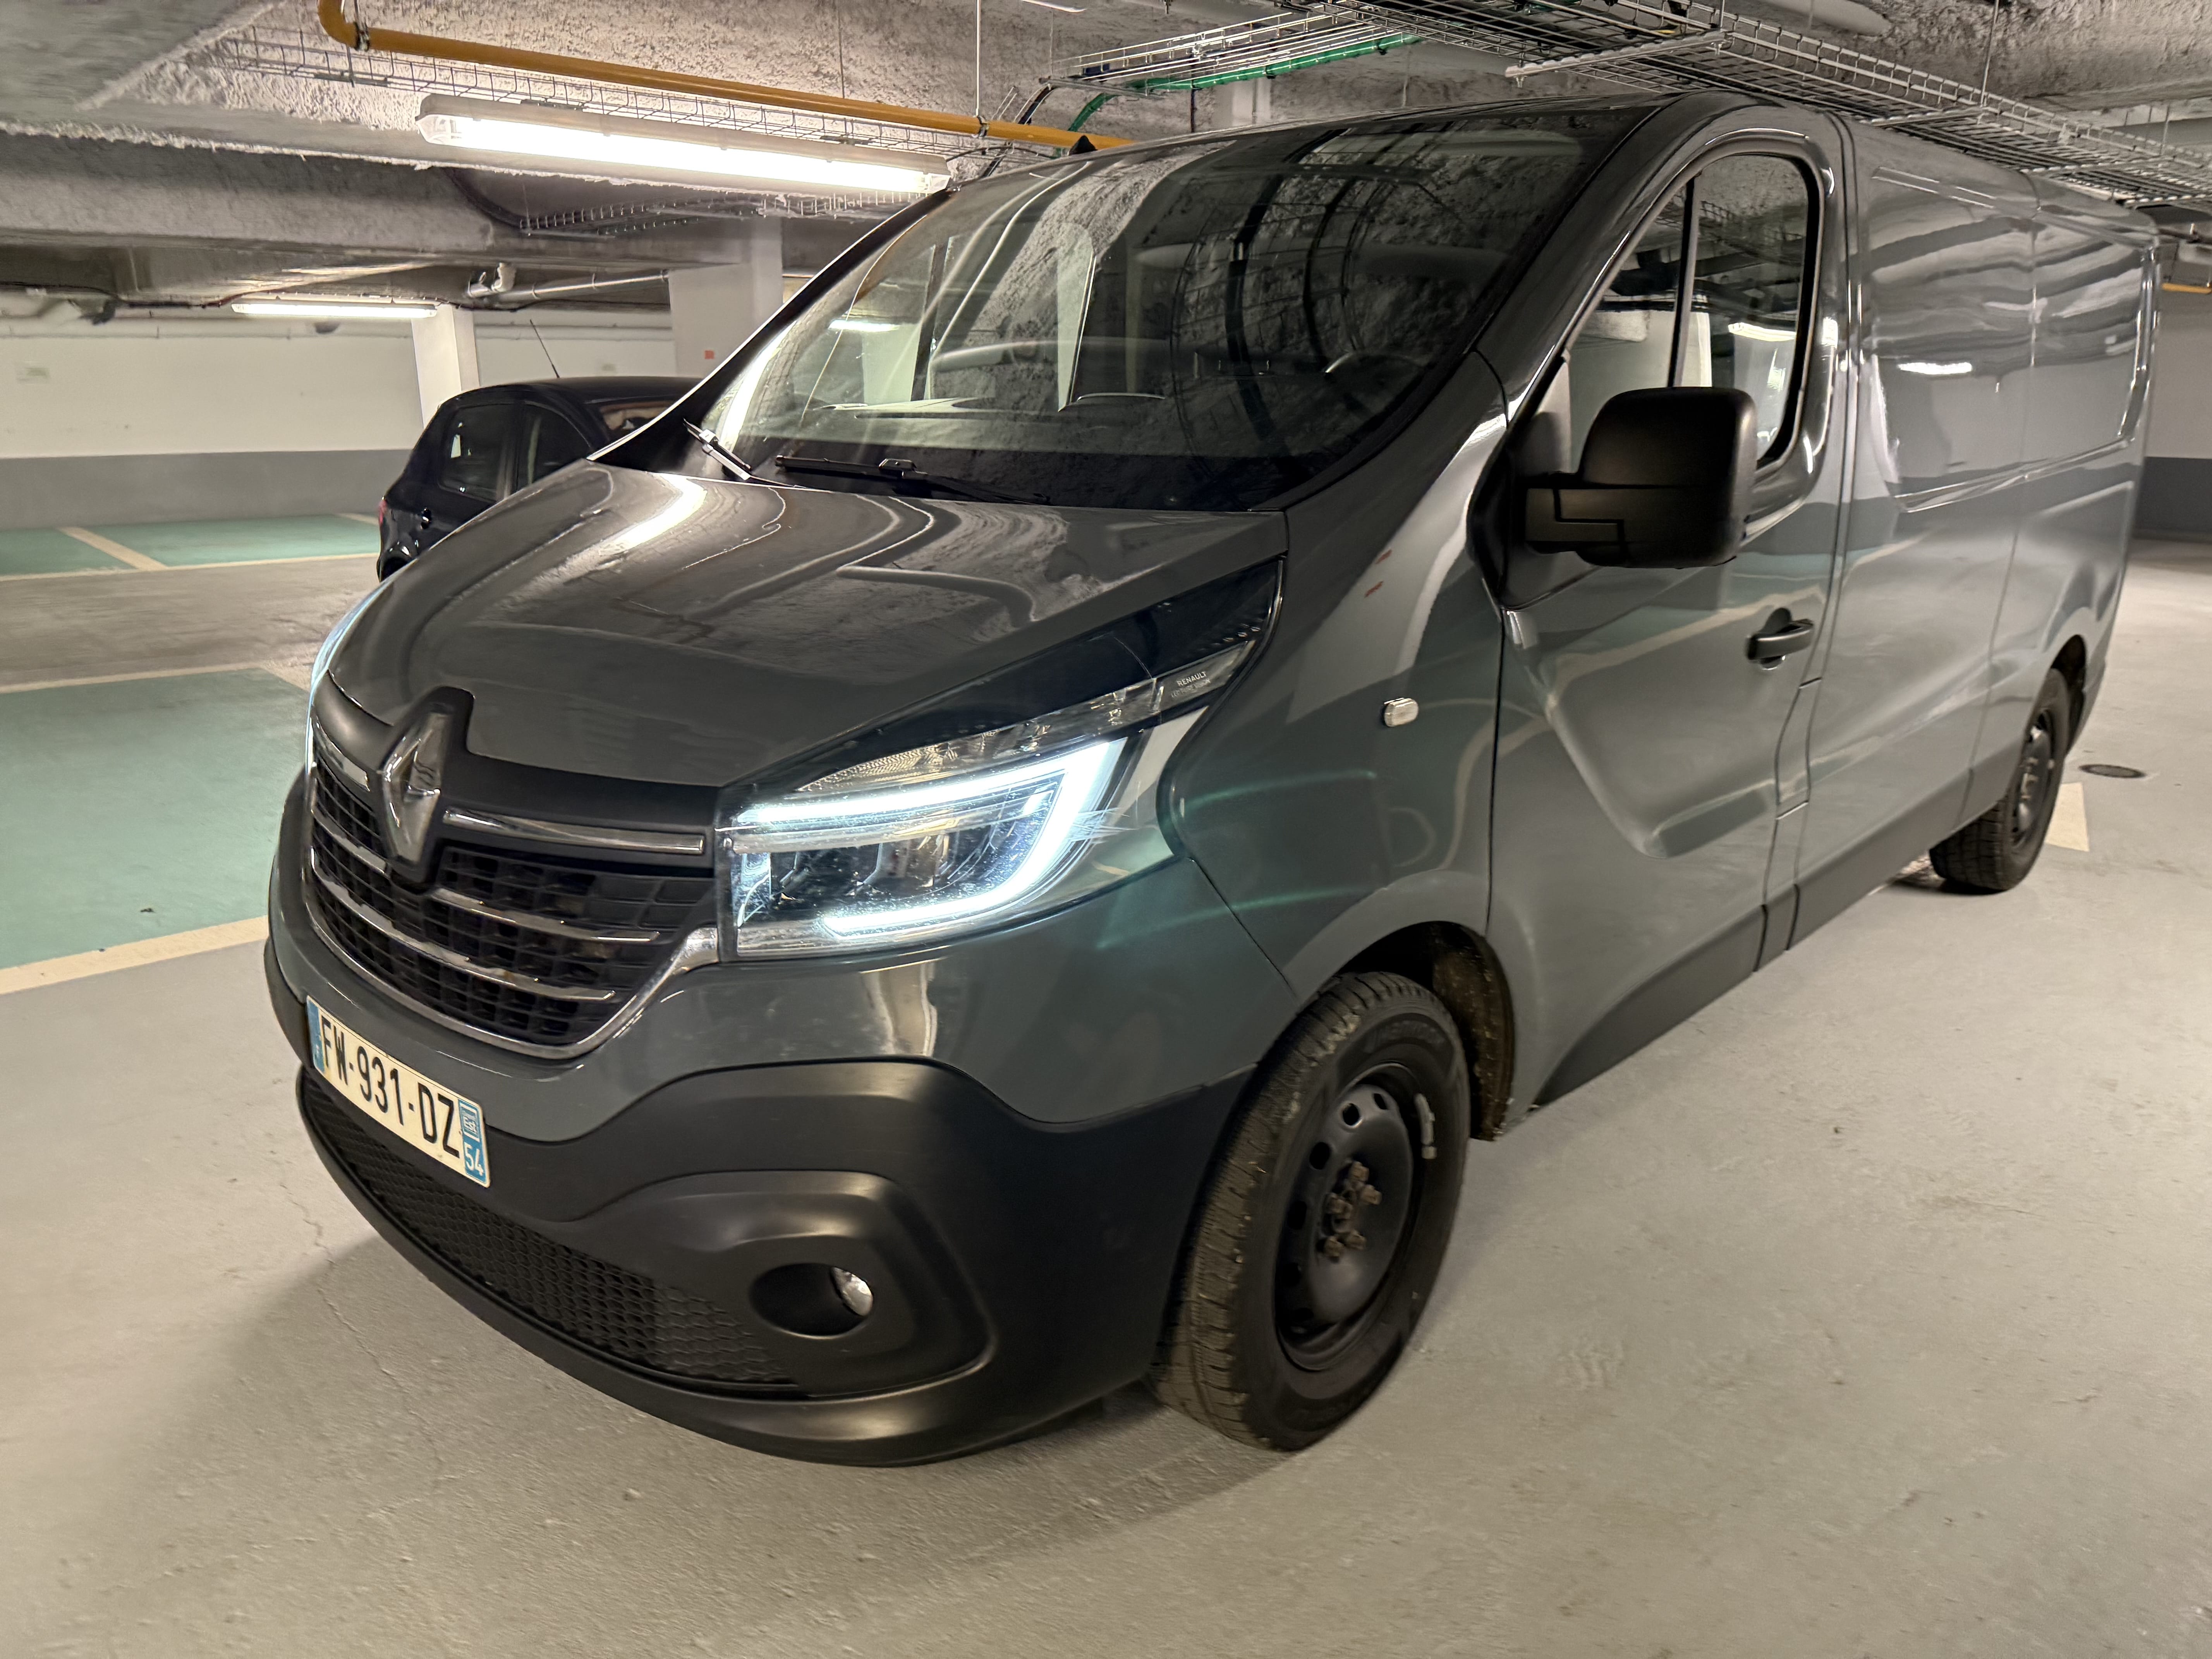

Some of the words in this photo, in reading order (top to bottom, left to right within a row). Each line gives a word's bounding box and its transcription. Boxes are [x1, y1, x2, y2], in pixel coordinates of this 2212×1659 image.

[1177, 671, 1206, 687] RENAULT
[321, 1015, 460, 1159] FW-931-DZ
[464, 1142, 484, 1176] 54
